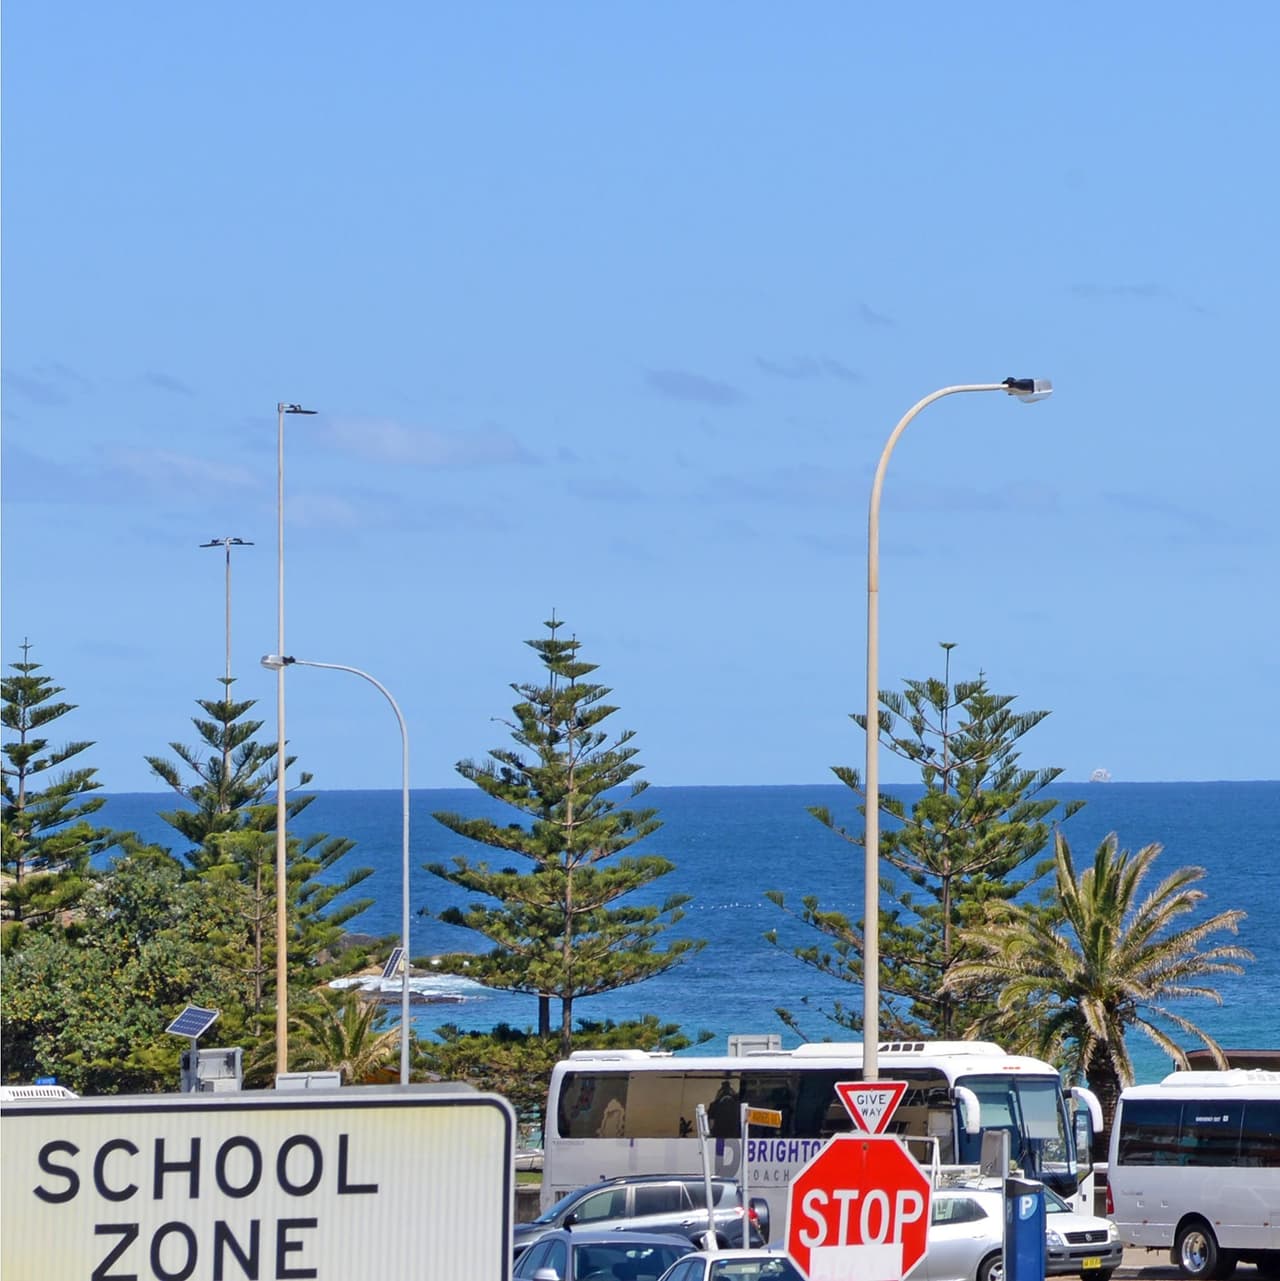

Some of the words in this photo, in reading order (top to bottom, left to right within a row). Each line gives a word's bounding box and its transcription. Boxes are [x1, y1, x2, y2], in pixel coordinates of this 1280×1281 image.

[857, 1094, 886, 1105] GIVE
[862, 1108, 881, 1117] WAY
[748, 1140, 826, 1163] BRIGHTO
[33, 1134, 378, 1204] SCHOOL
[747, 1169, 790, 1181] OACH
[1022, 1195, 1033, 1216] P
[799, 1188, 924, 1248] STOP
[91, 1217, 318, 1281] ZONE
